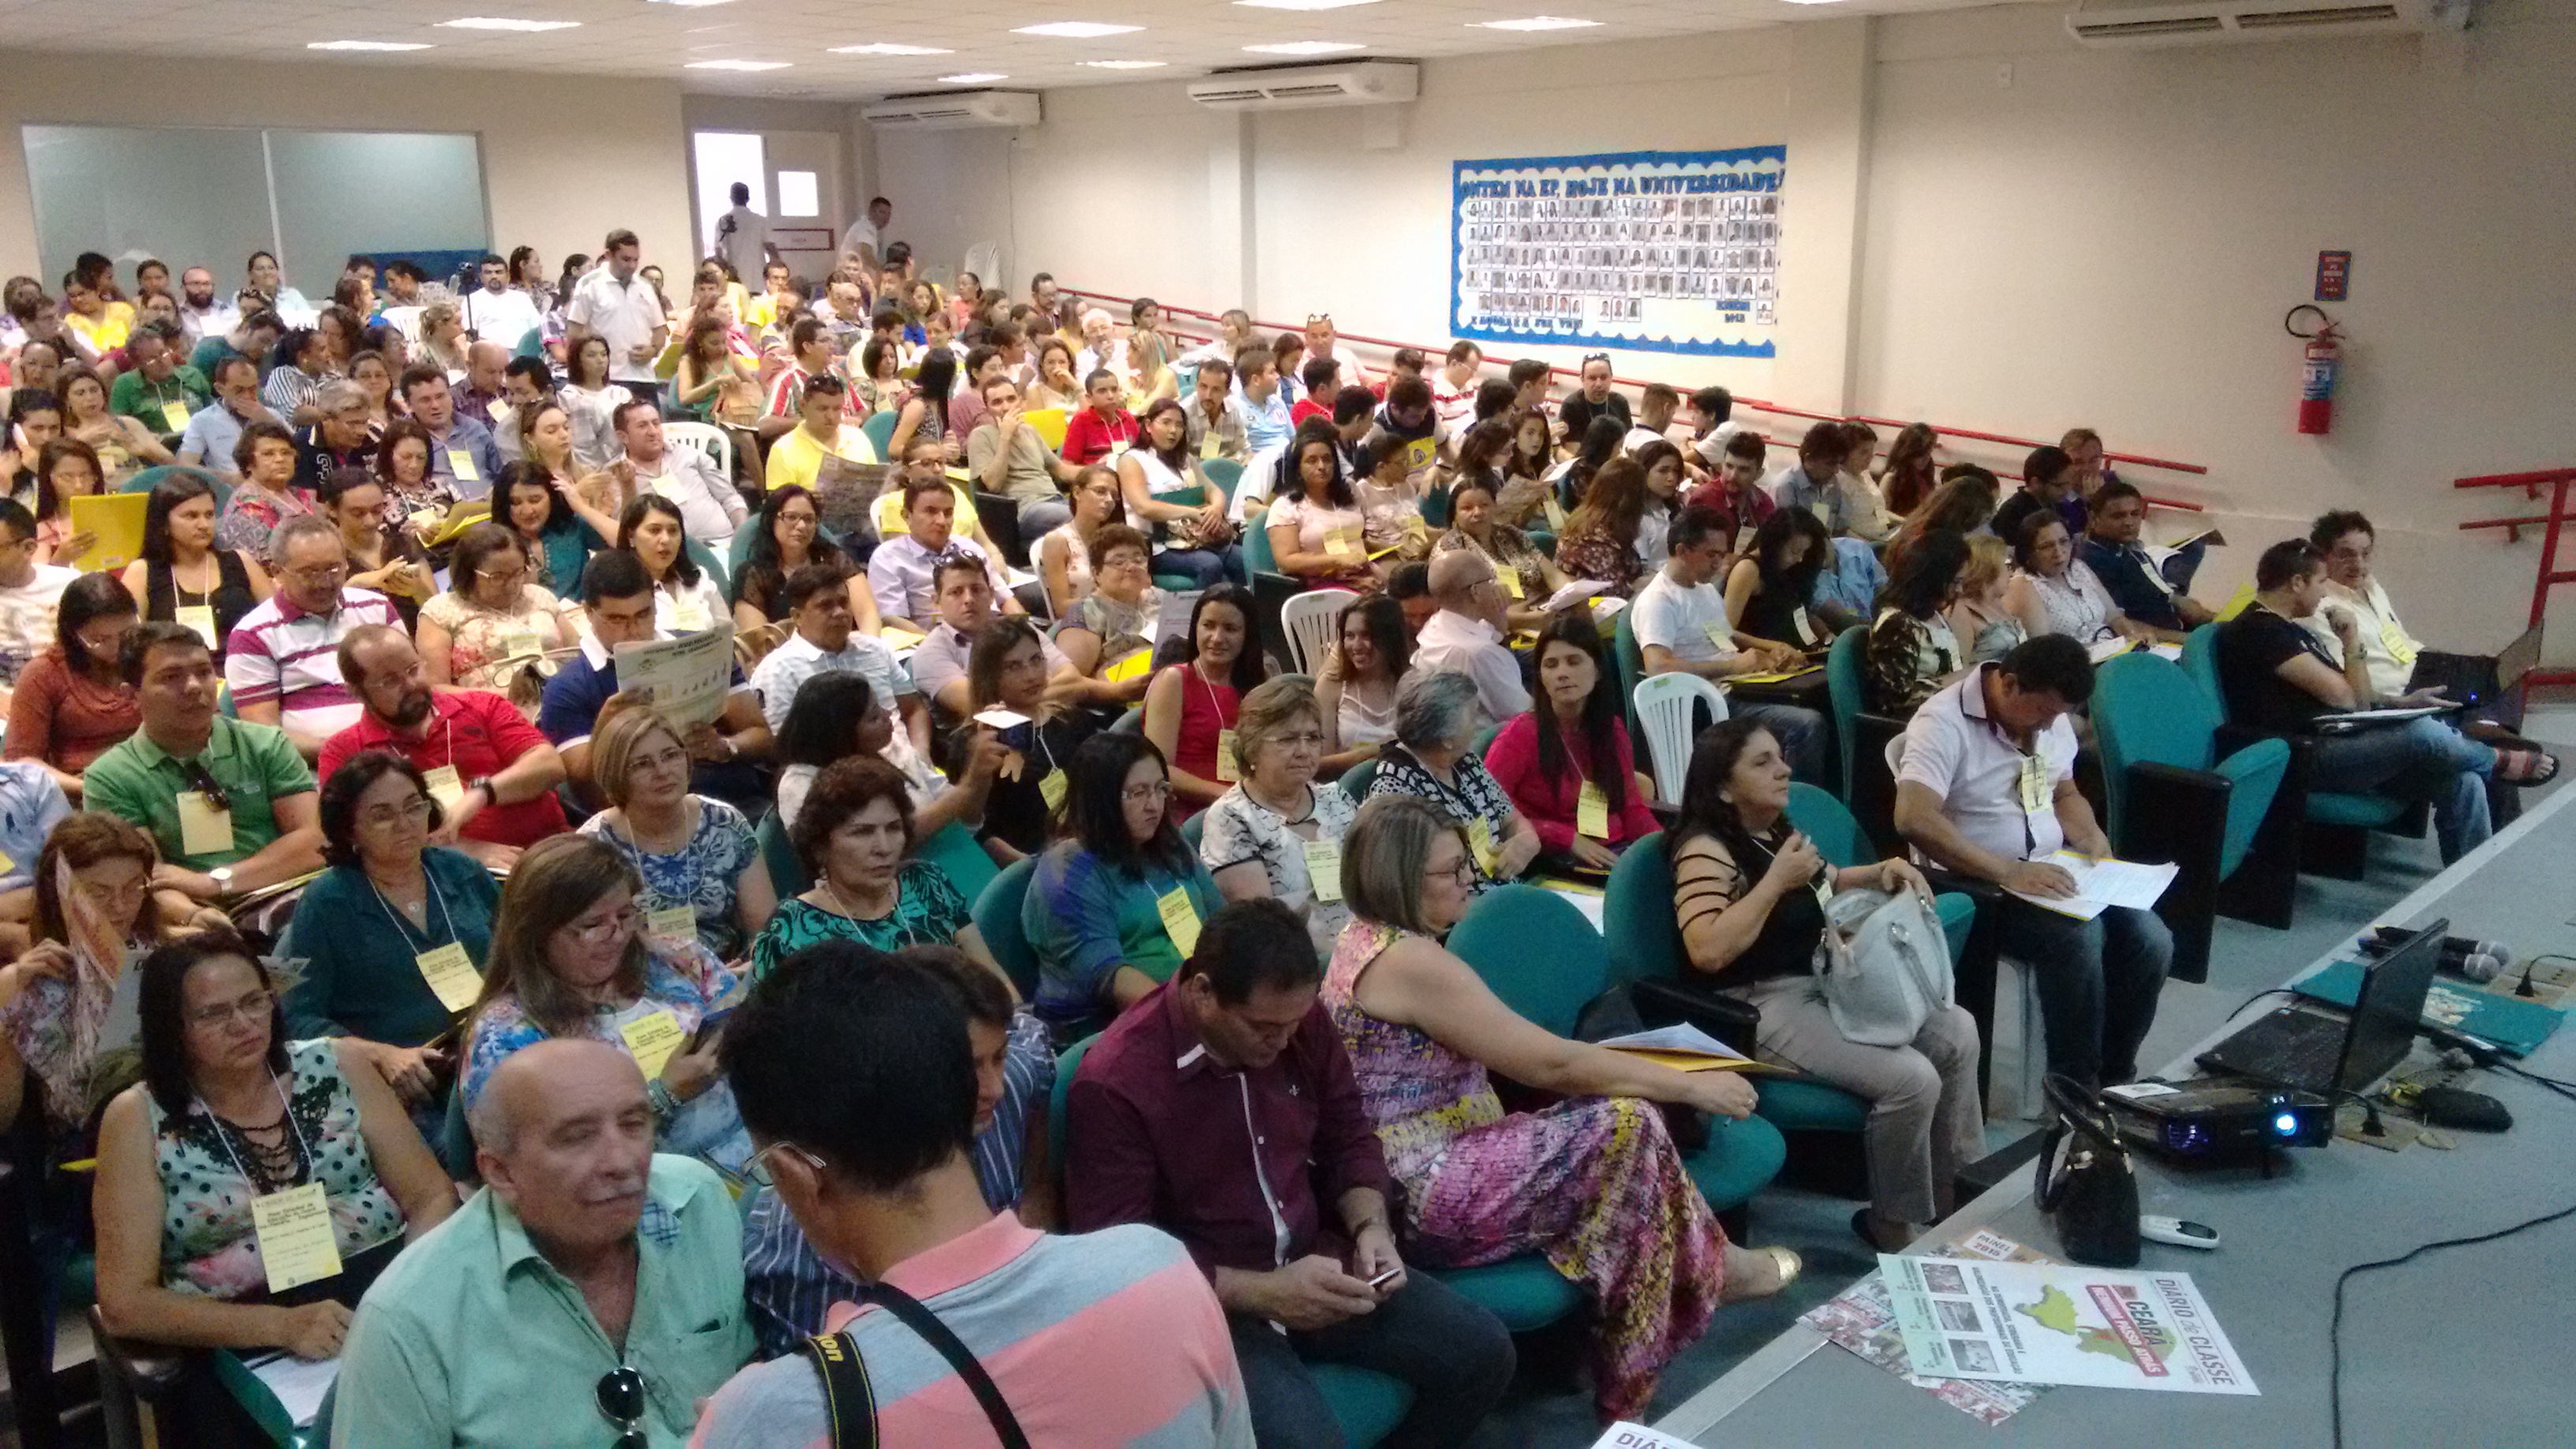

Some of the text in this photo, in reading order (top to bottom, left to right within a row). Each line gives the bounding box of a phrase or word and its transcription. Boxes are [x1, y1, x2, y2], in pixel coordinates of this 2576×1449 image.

[1461, 180, 1511, 198] ONTEM
[1515, 179, 1537, 198] NA
[1565, 177, 1608, 197] HOJE
[1612, 176, 1637, 197] NA
[1639, 168, 1786, 195] UNIVERSIDADE!
[1977, 1234, 2012, 1252] PAINEL
[2114, 1319, 2143, 1346] PASSO
[2125, 1301, 2174, 1346] CEARÁ
[2155, 1279, 2235, 1386] DIÁRIO de CLASSE
